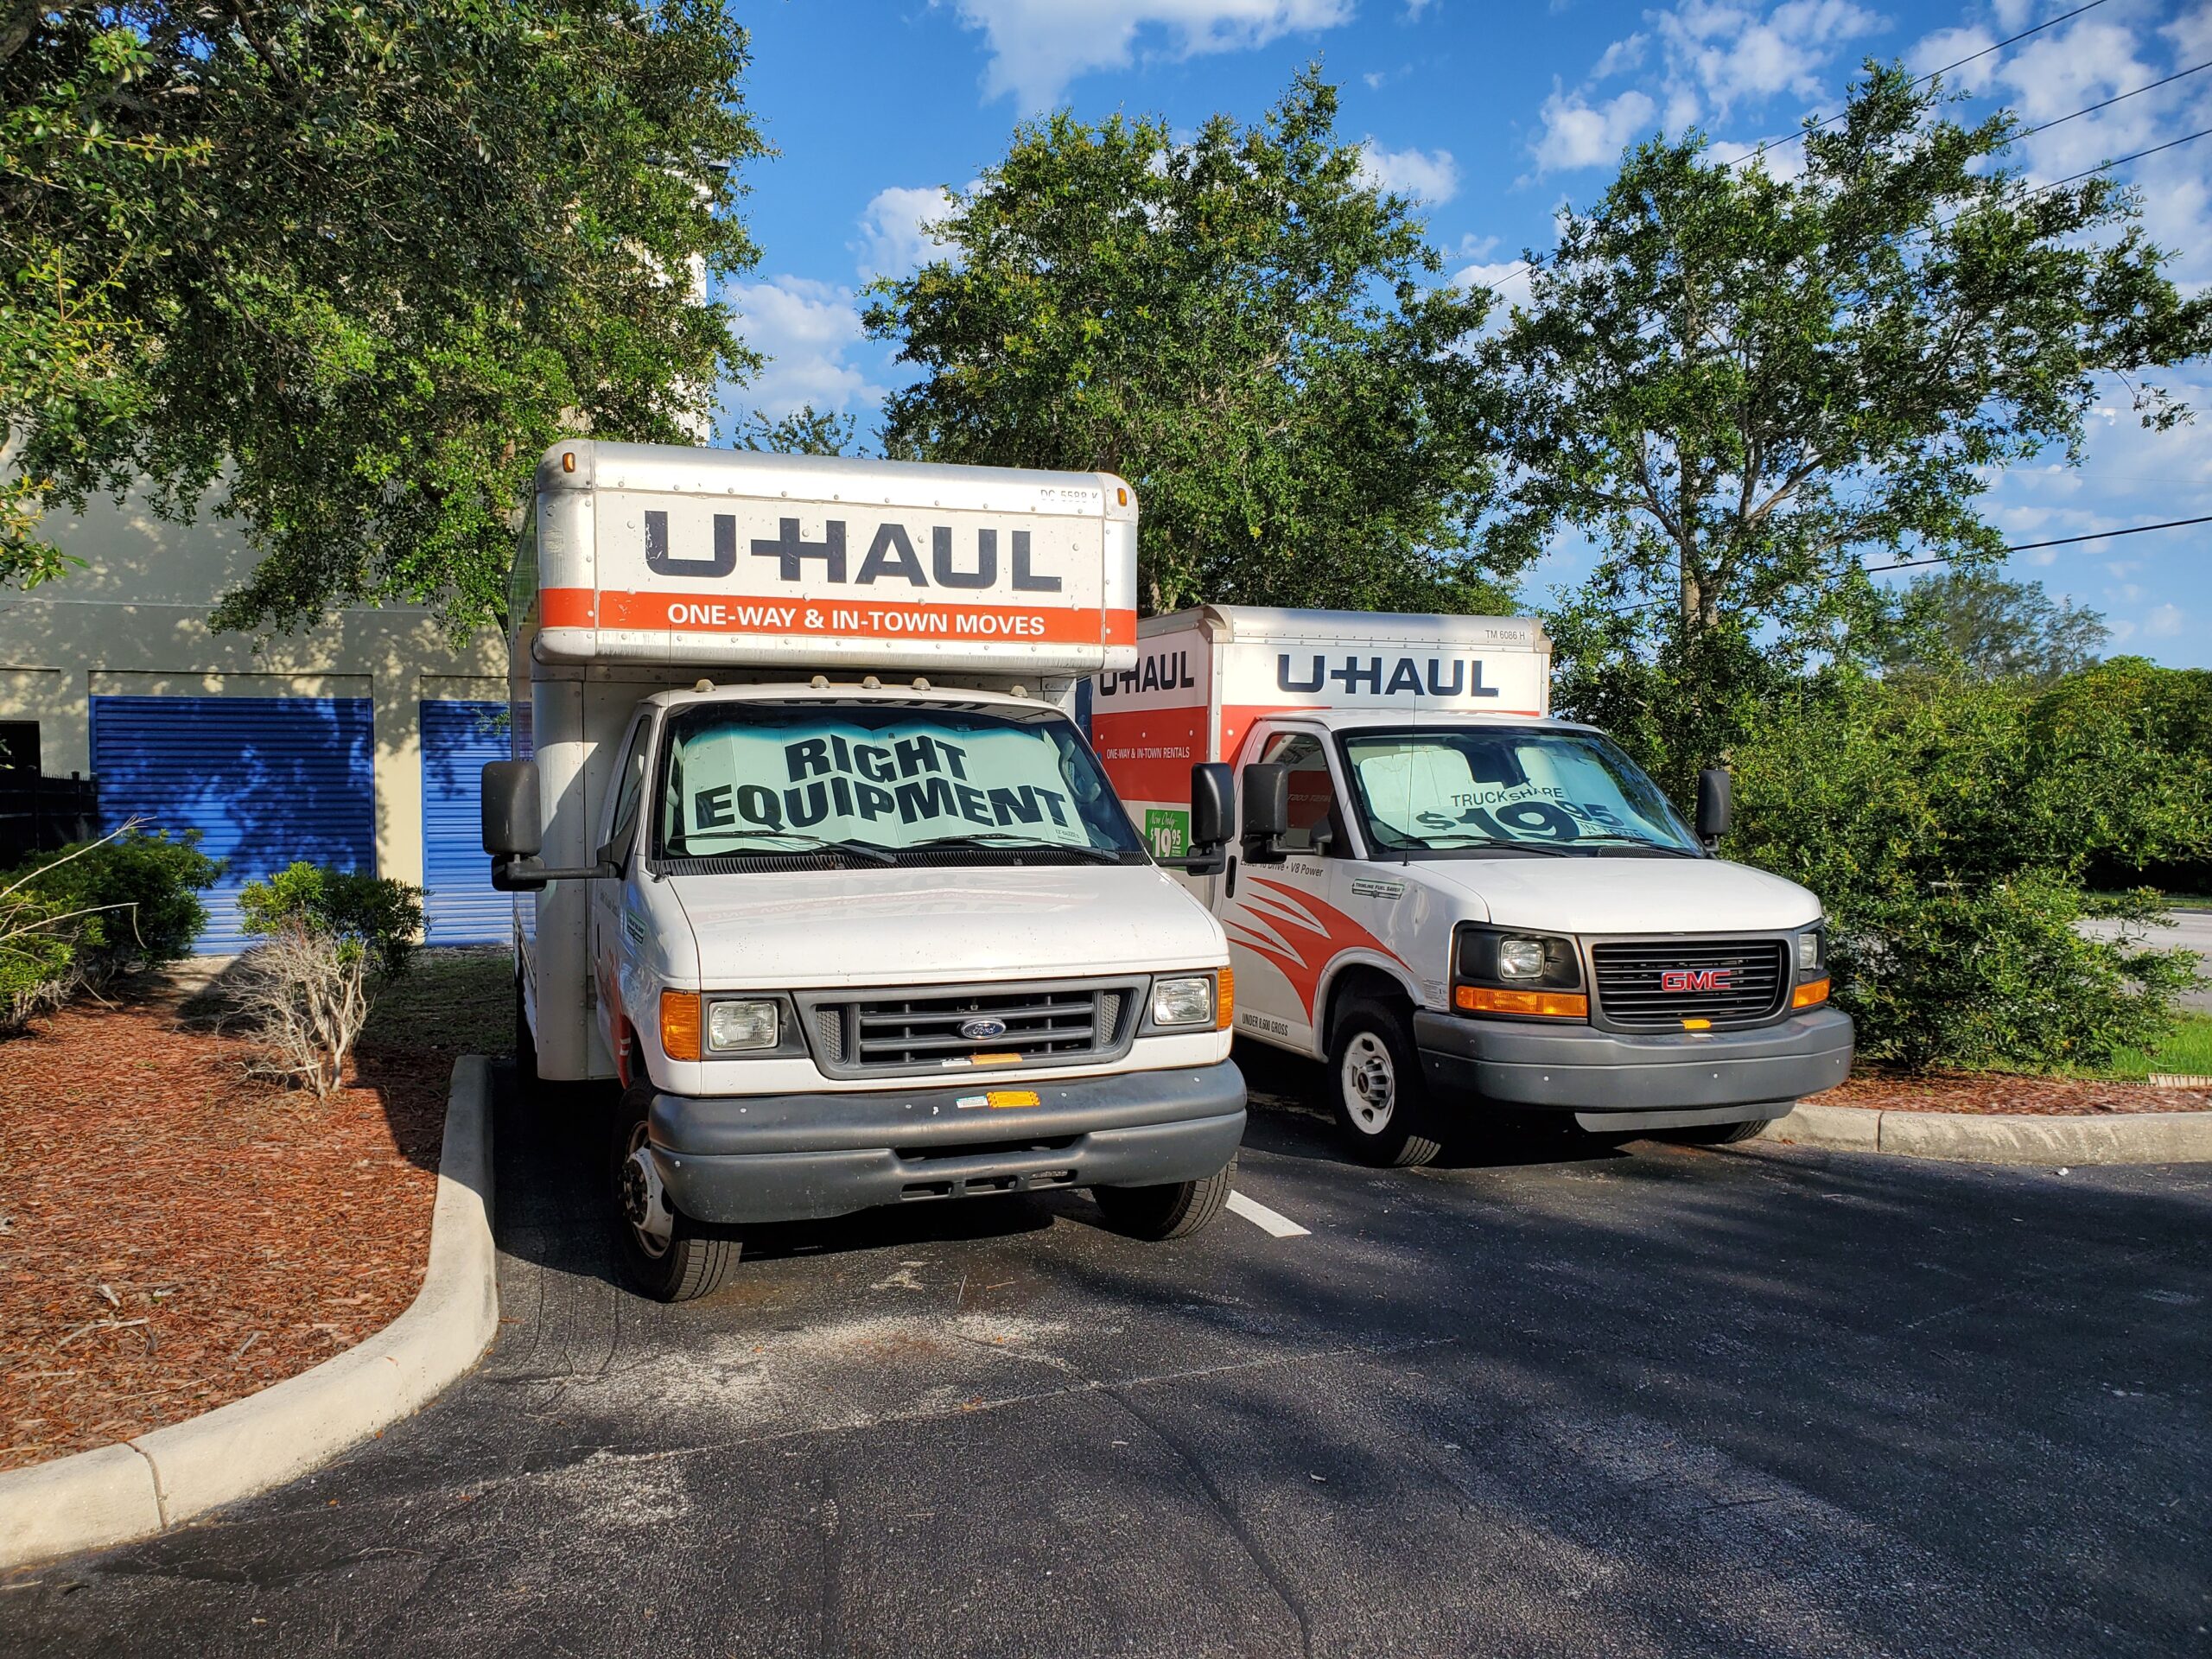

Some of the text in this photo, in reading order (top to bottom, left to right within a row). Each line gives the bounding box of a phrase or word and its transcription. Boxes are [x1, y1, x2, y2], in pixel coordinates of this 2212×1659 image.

[645, 510, 1062, 593] U-HAUL
[667, 603, 1046, 635] ONE-WAY & IN-TOWN MOVES
[1484, 629, 1526, 640] TM 6086 H
[1100, 651, 1195, 696] U-HAUL
[1277, 654, 1499, 697] U-HAUL
[785, 734, 968, 783] RIGHT
[1106, 747, 1191, 760] ONE-WAY & IN-TOWN RENTALS
[695, 776, 1069, 831] EQUIPMENT
[1150, 812, 1161, 824] Now
[1291, 862, 1300, 874] V8
[1300, 864, 1324, 877] Power
[1662, 970, 1731, 992] GMC
[1243, 1012, 1288, 1036] UNDER 8,600 GROSS
